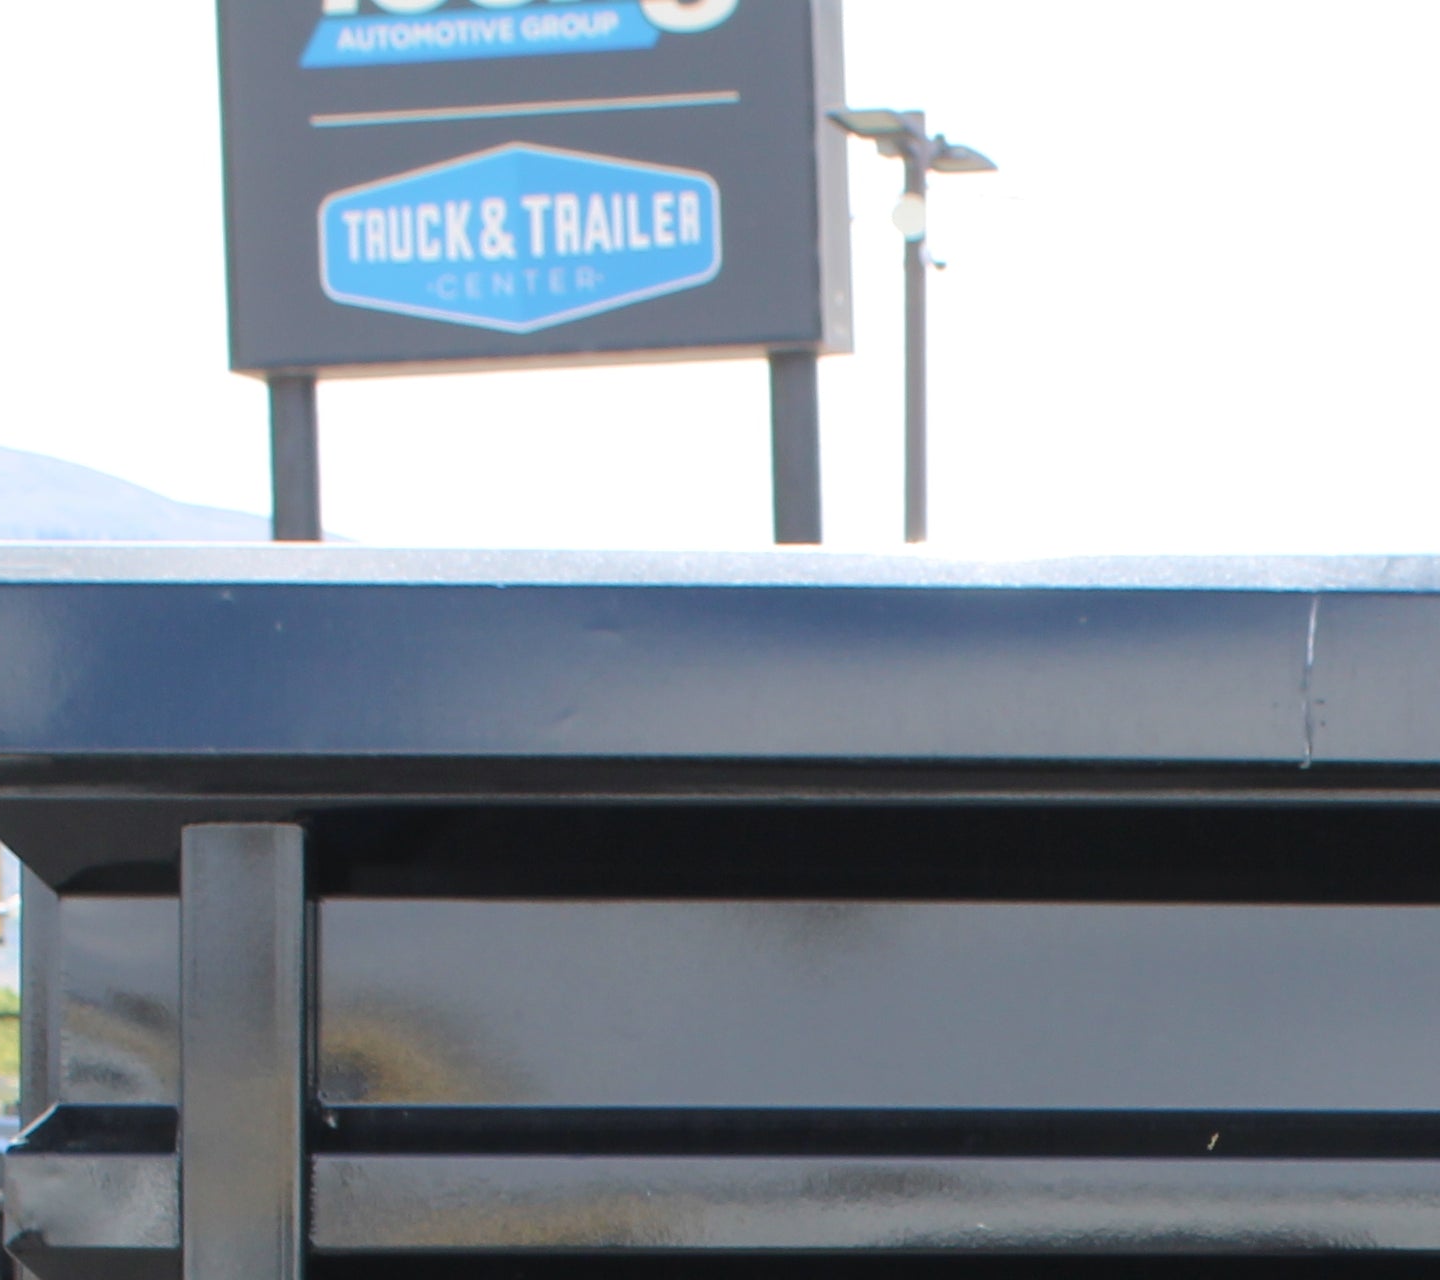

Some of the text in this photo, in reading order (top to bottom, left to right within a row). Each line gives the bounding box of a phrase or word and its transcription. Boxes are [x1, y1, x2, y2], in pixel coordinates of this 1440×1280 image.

[336, 13, 514, 51] AUTOMOTIVE
[520, 11, 620, 41] GROUP
[521, 190, 702, 258] TRAILER
[435, 265, 598, 300] CENTER
